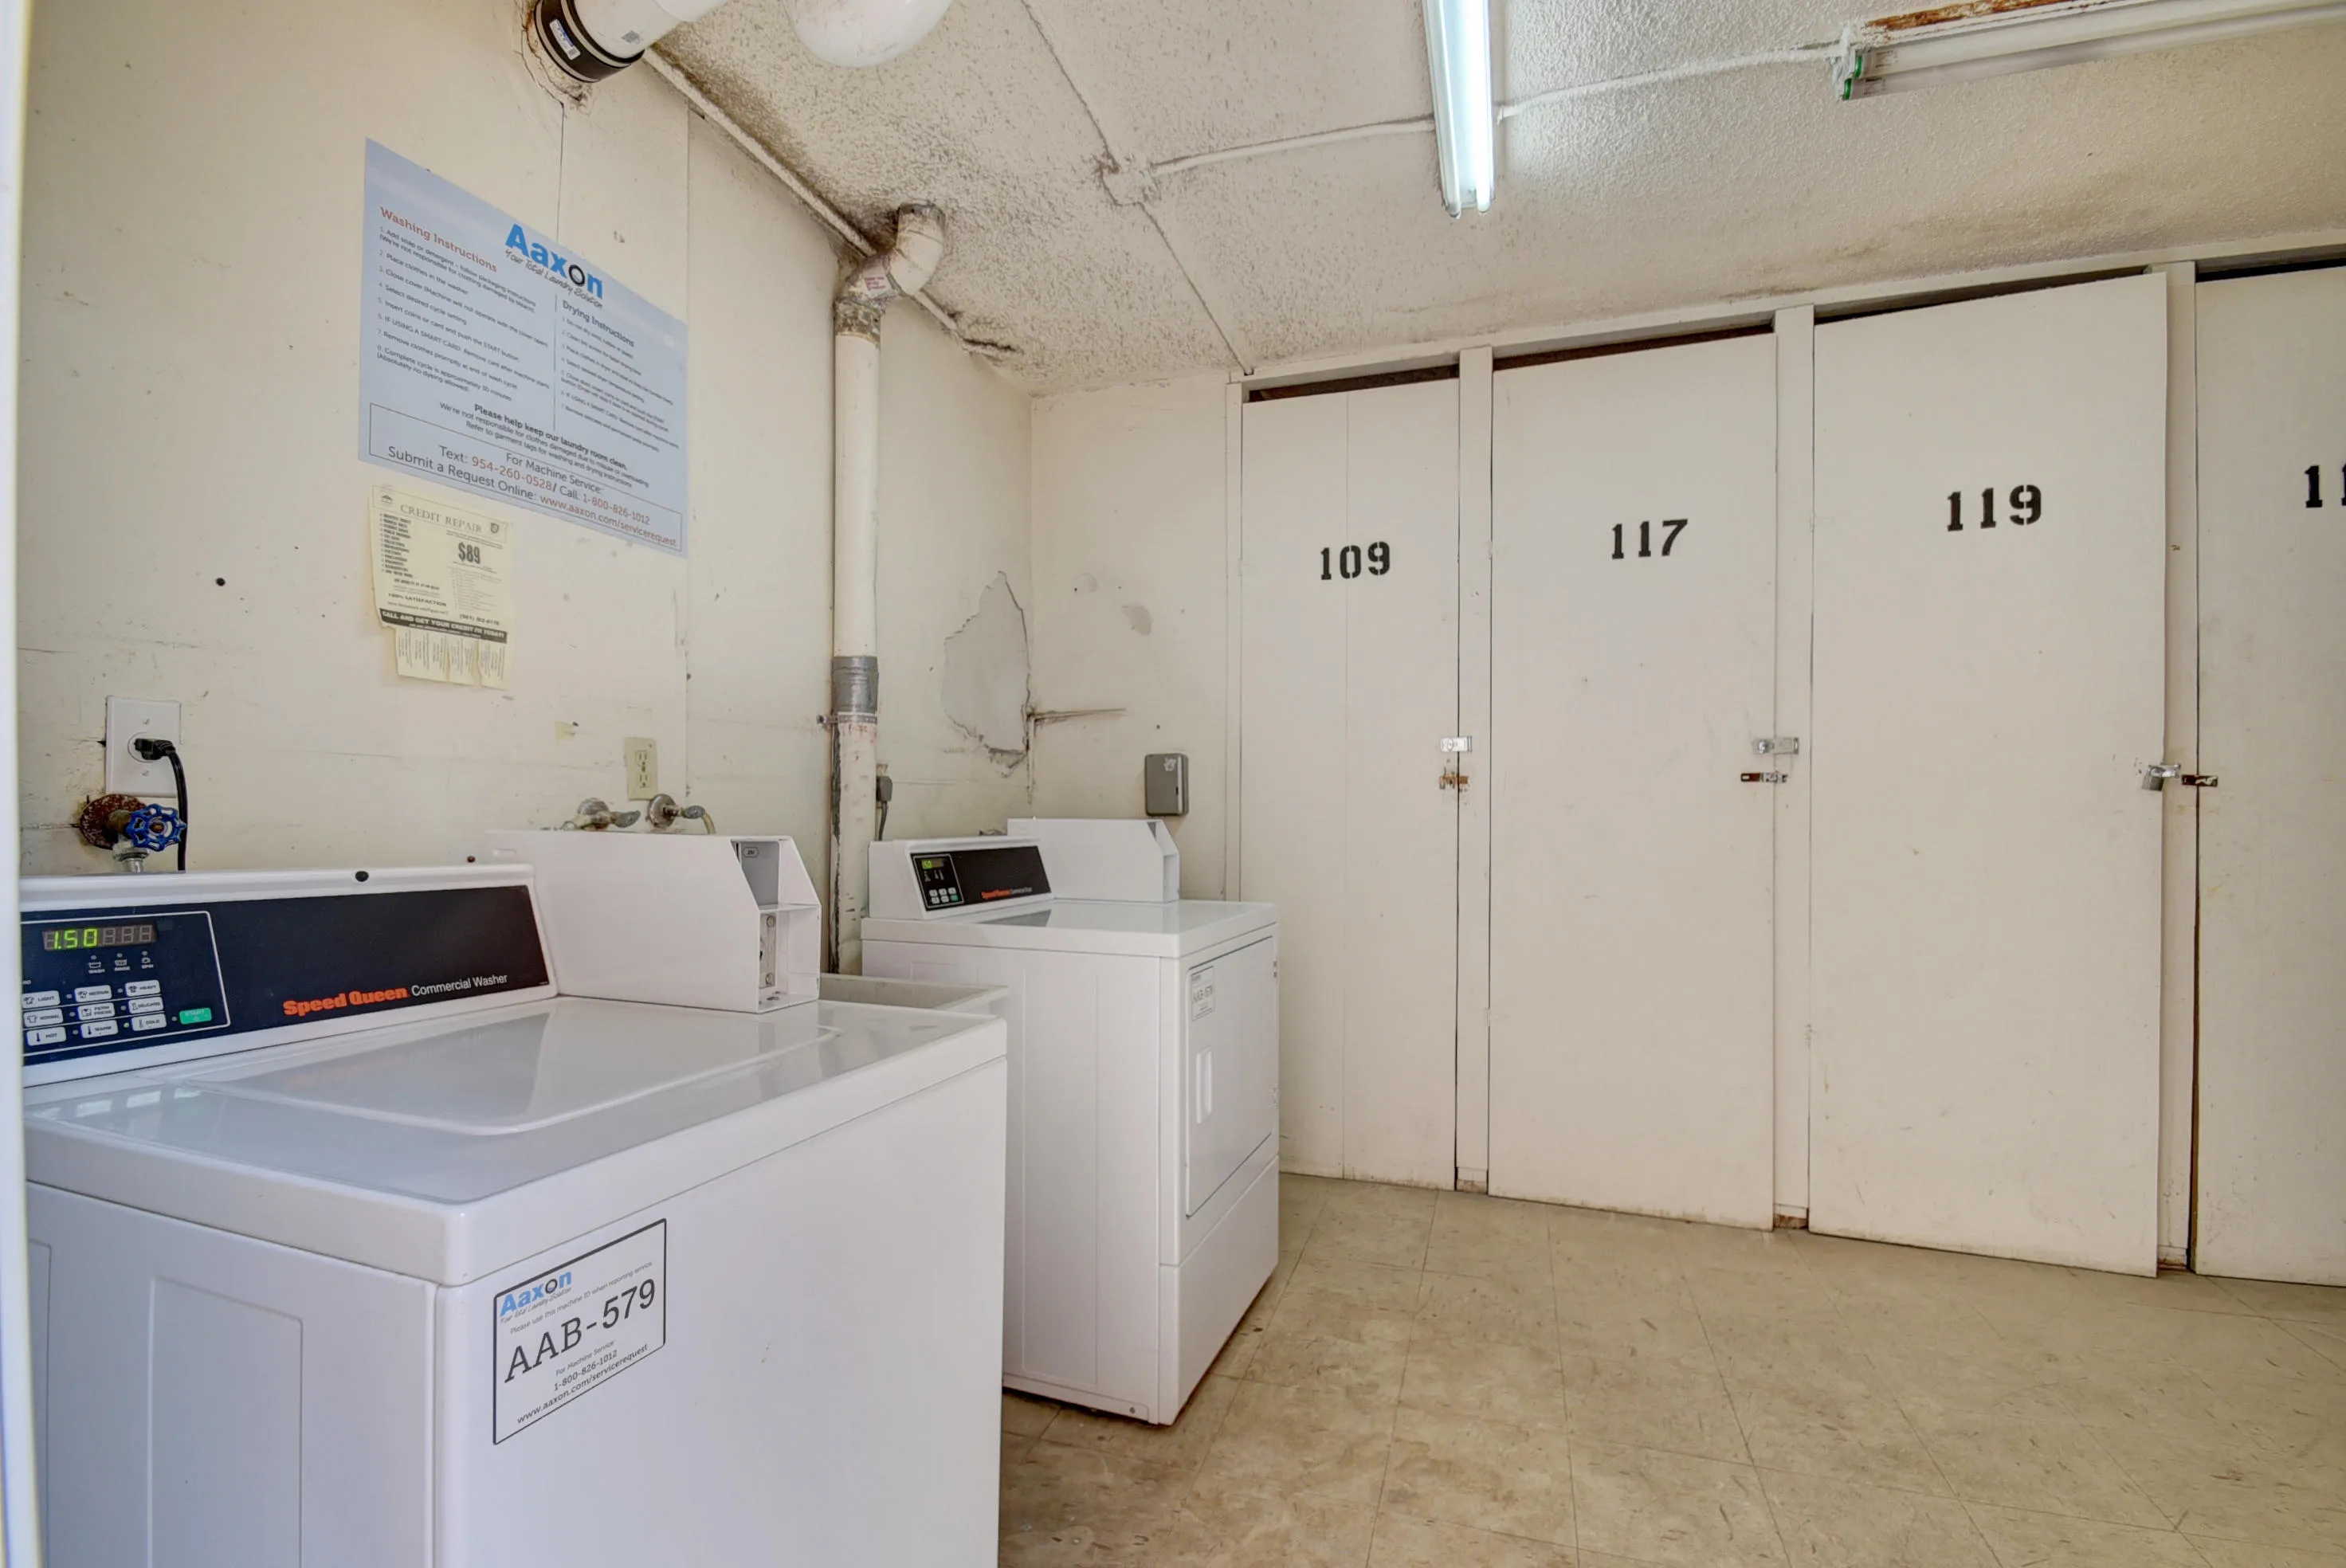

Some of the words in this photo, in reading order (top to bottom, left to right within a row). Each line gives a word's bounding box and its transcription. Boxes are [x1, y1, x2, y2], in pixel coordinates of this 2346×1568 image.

[380, 206, 430, 241] Washing
[434, 232, 496, 273] Instructions
[386, 228, 399, 240] Add
[401, 244, 411, 254] not
[385, 268, 403, 282] Close
[386, 252, 403, 265] Place
[505, 223, 602, 300] Aaxon
[385, 300, 402, 312] Insert
[386, 284, 404, 297] Select
[392, 318, 413, 332] USING
[563, 299, 590, 323] Drying
[591, 315, 634, 348] Instructions
[440, 402, 460, 415] We're
[461, 410, 473, 420] not
[476, 414, 513, 435] responsible
[525, 433, 547, 447] clothes
[465, 420, 483, 432] Refer
[485, 427, 493, 436] to
[495, 431, 522, 448] garment
[524, 441, 536, 453] tags
[474, 403, 501, 421] Please
[504, 414, 523, 429] help
[524, 422, 543, 437] keep
[545, 432, 559, 442] our
[560, 436, 588, 455] laundry
[590, 449, 607, 461] room
[609, 457, 627, 470] clean.
[439, 444, 468, 465] Text:
[583, 492, 649, 525] 1-800-826-1012
[506, 452, 522, 468] For
[525, 458, 567, 482] Machine
[569, 473, 602, 495] Service:
[388, 444, 434, 470] Submit
[437, 462, 444, 472] a
[448, 463, 494, 491] Request
[498, 479, 536, 501] Online:
[540, 495, 676, 547] www.aaxon.com/servicerequest
[1948, 485, 2041, 531] 119
[400, 504, 441, 522] CREDIT
[445, 516, 482, 533] REPAIR
[1613, 519, 1687, 559] 117
[458, 542, 481, 564] $89
[1321, 542, 1390, 580] 109
[53, 928, 99, 949] 1.50
[284, 991, 347, 1017] Speed
[348, 984, 408, 1006] Queen
[411, 977, 472, 998] Commercial
[473, 973, 508, 988] Washer
[499, 1270, 572, 1317] Aaxon
[511, 1319, 530, 1335] Please
[532, 1315, 543, 1327] use
[545, 1308, 555, 1320] this
[556, 1295, 583, 1315] machine
[583, 1291, 590, 1301] ID
[591, 1285, 606, 1299] when
[609, 1271, 634, 1290] reporting
[504, 1278, 655, 1383] AAB-579
[516, 1343, 648, 1425] www.aaxon.com/servicerequest
[554, 1350, 618, 1391] 1-800-826-1012
[555, 1366, 566, 1377] For
[567, 1352, 591, 1370] Machine
